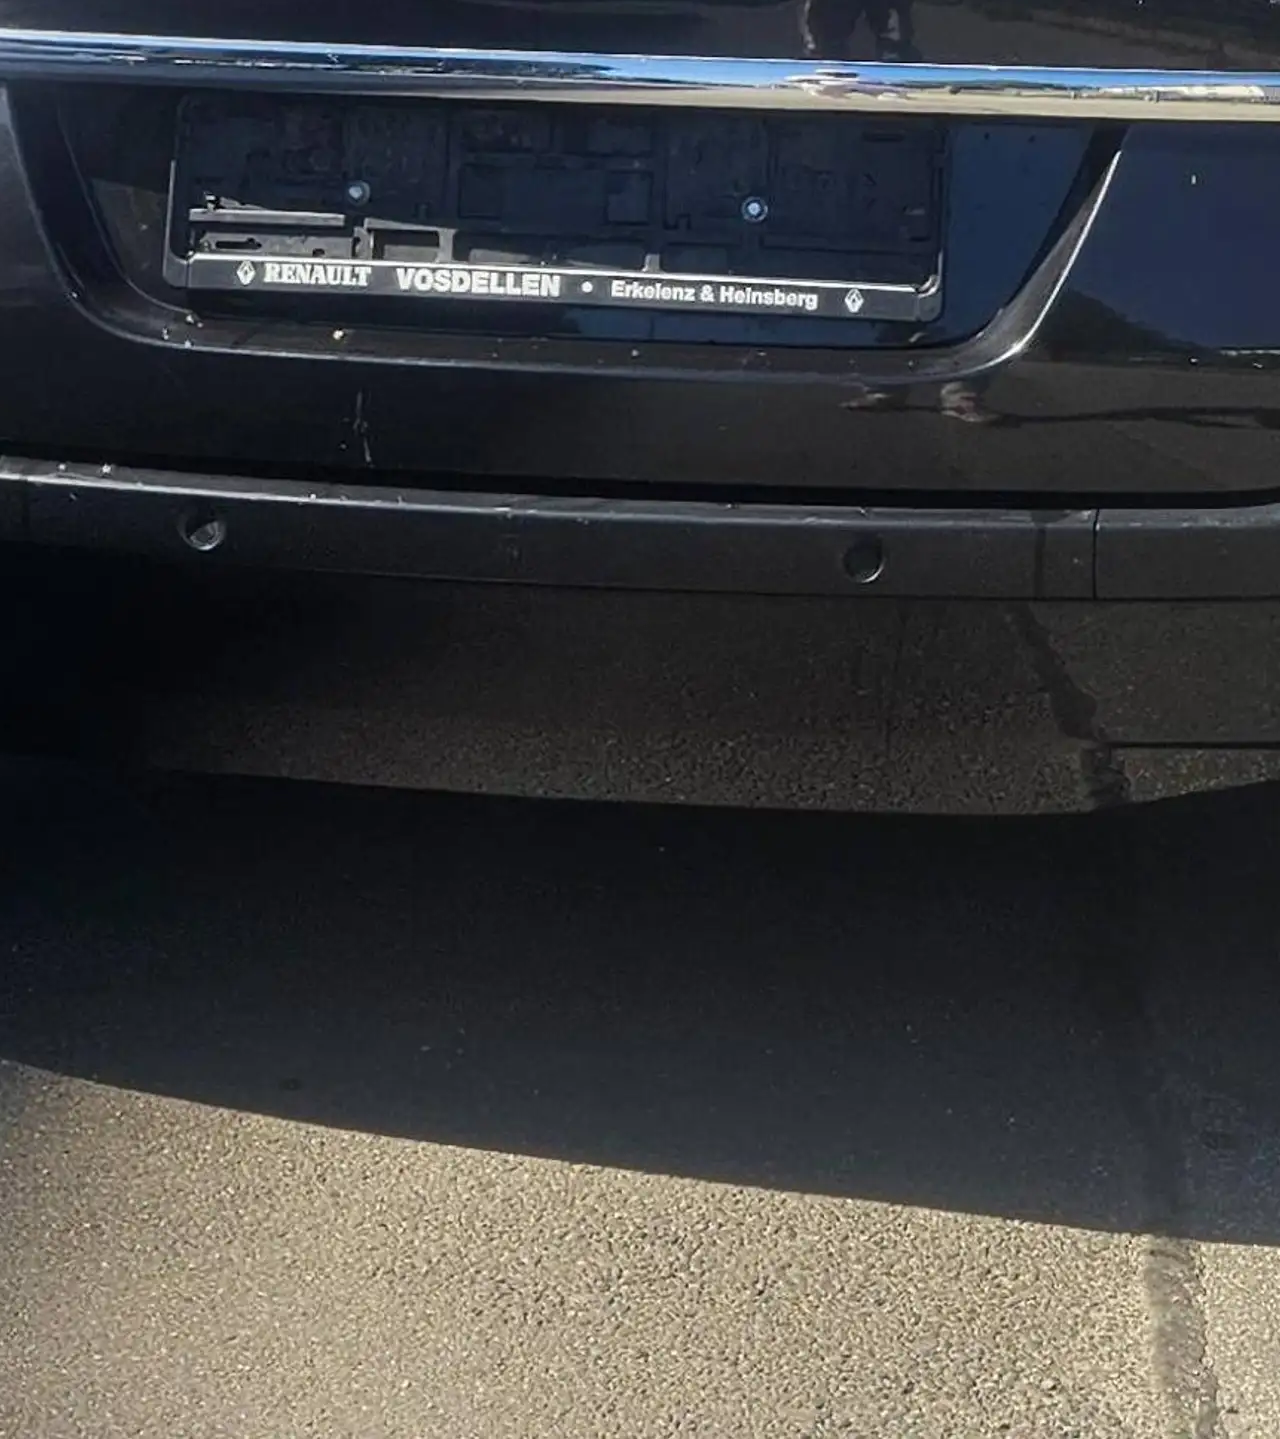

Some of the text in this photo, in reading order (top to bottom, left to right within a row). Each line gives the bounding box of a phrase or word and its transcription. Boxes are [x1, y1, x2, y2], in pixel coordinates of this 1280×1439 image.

[263, 262, 818, 311] RENAULT VOSDELLEN Erkelenz & Heinsberg
